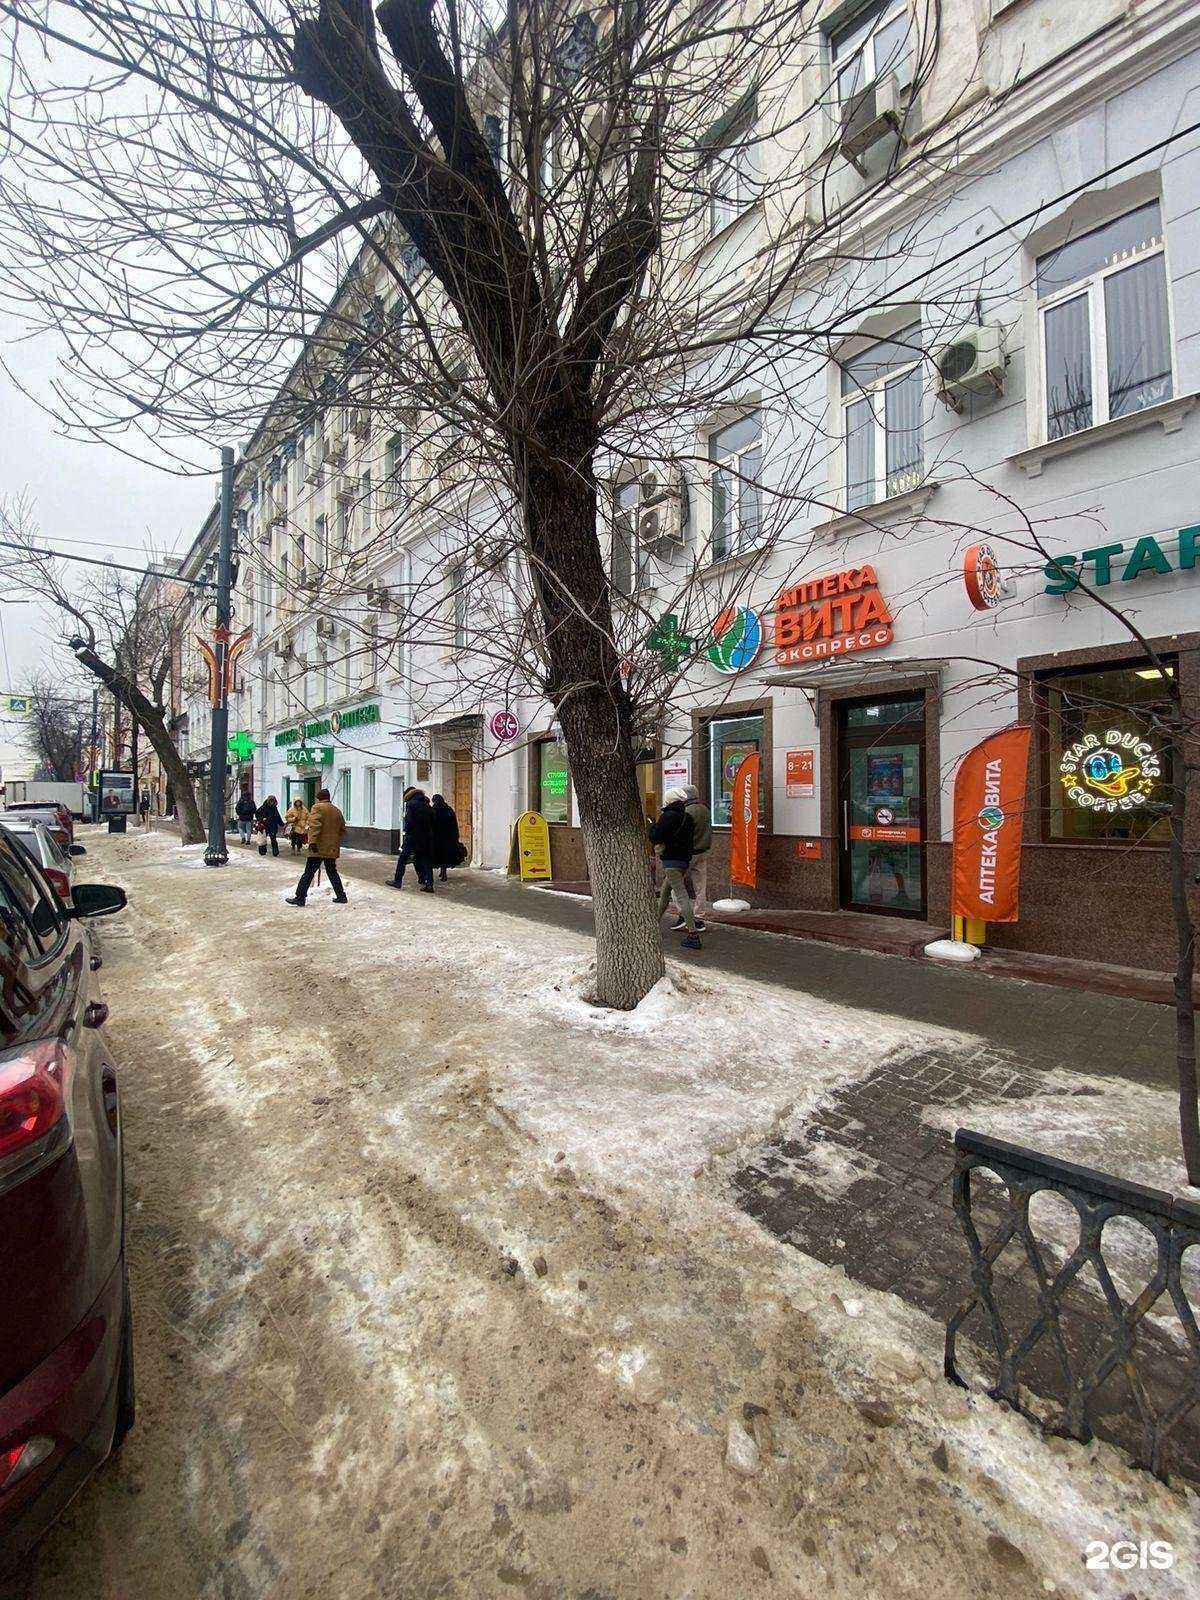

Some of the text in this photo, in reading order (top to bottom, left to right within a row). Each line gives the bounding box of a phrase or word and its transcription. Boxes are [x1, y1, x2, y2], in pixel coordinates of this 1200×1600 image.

[775, 564, 878, 612] АПТЕКА
[774, 588, 894, 647] ВИТА
[776, 629, 889, 663] ЭКСПРЕСС
[1060, 730, 1161, 777] STAR DUCKS
[1067, 786, 1146, 813] COFFEE
[978, 758, 1002, 905] АПТЕКА ВИТА
